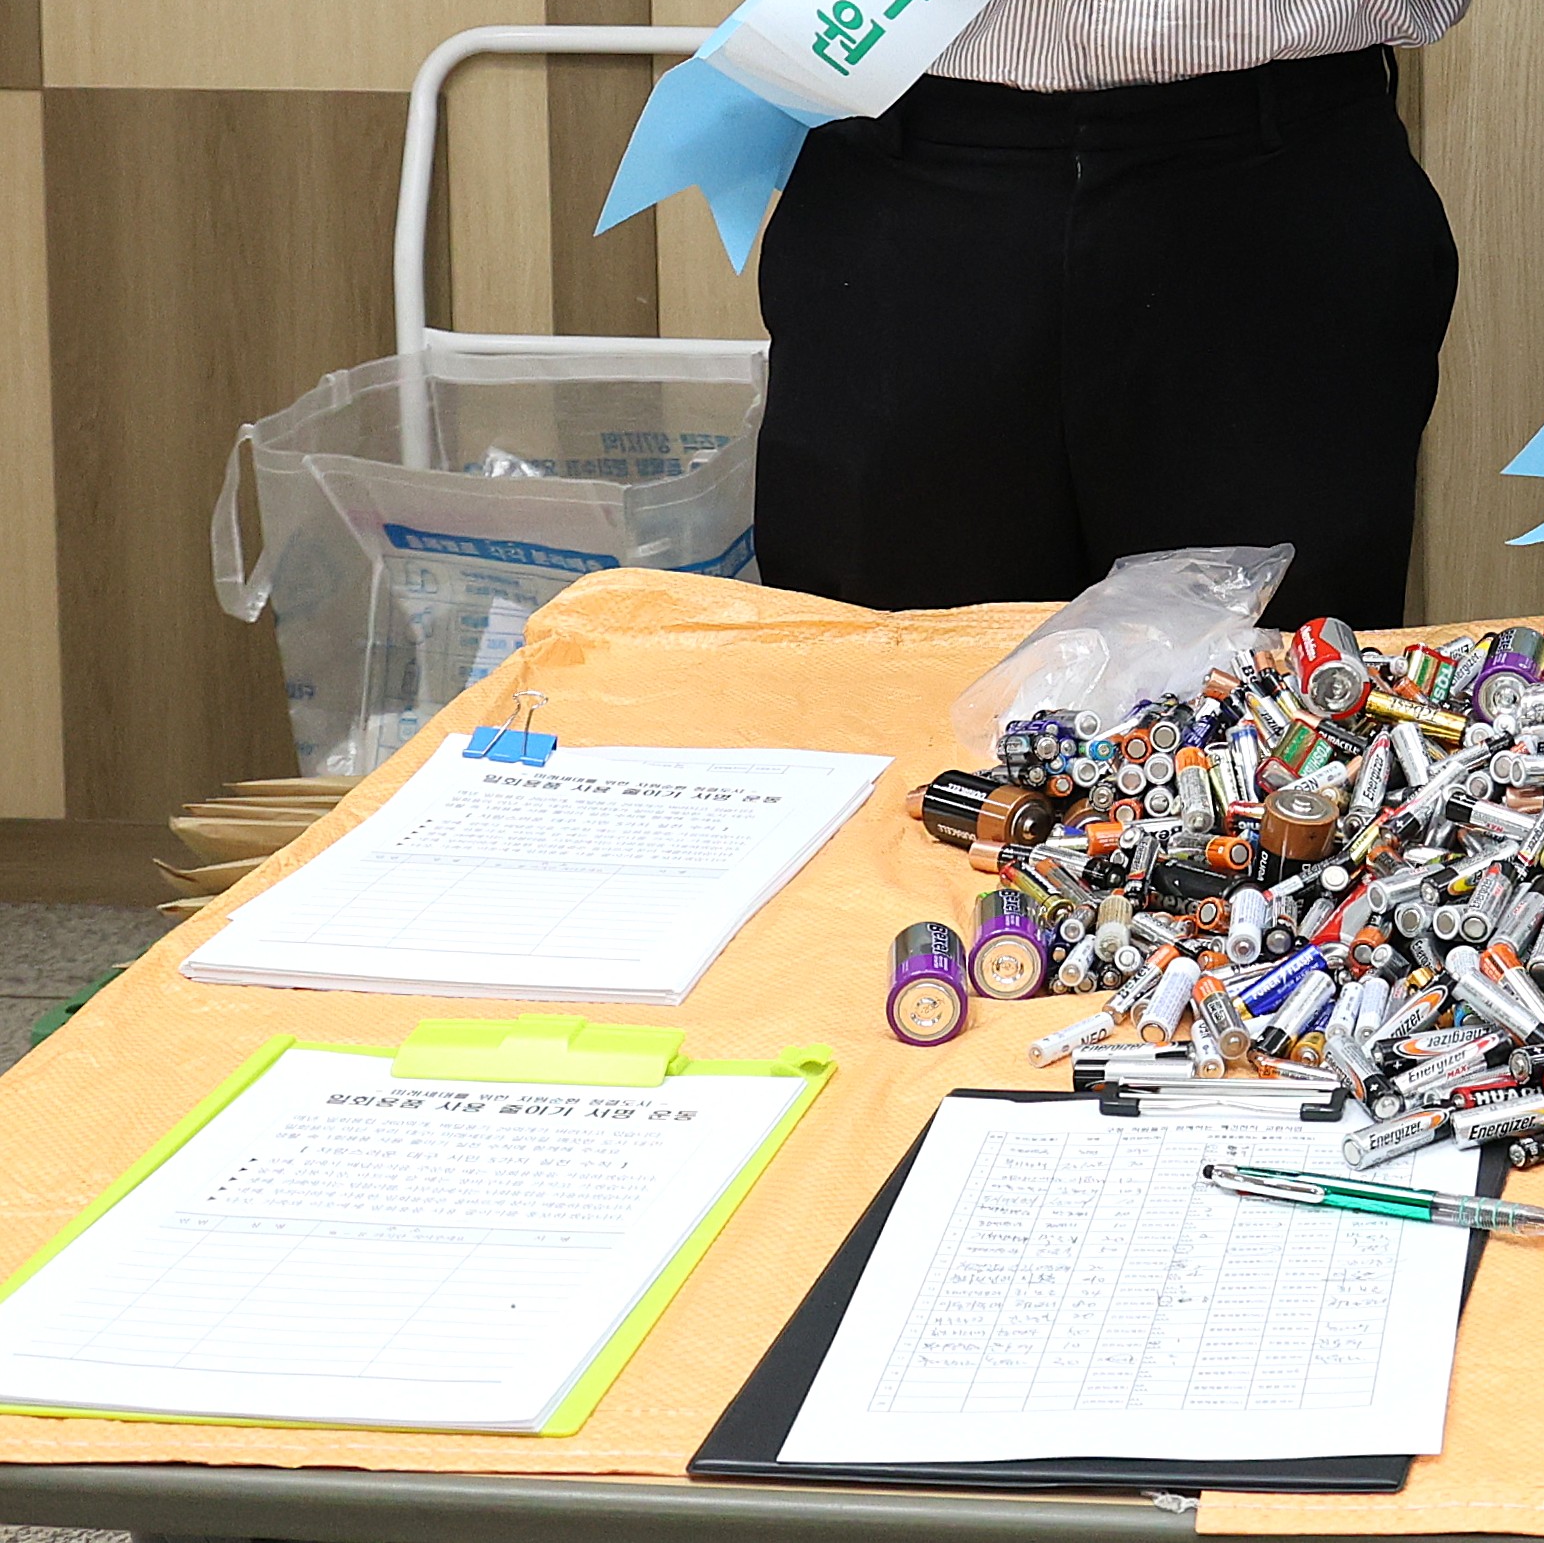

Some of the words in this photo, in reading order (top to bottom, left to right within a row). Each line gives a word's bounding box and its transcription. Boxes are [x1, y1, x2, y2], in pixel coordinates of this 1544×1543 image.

[436, 1102, 486, 1112] 사용
[1369, 1119, 1425, 1150] Energizer
[1468, 1114, 1537, 1140] Energizer
